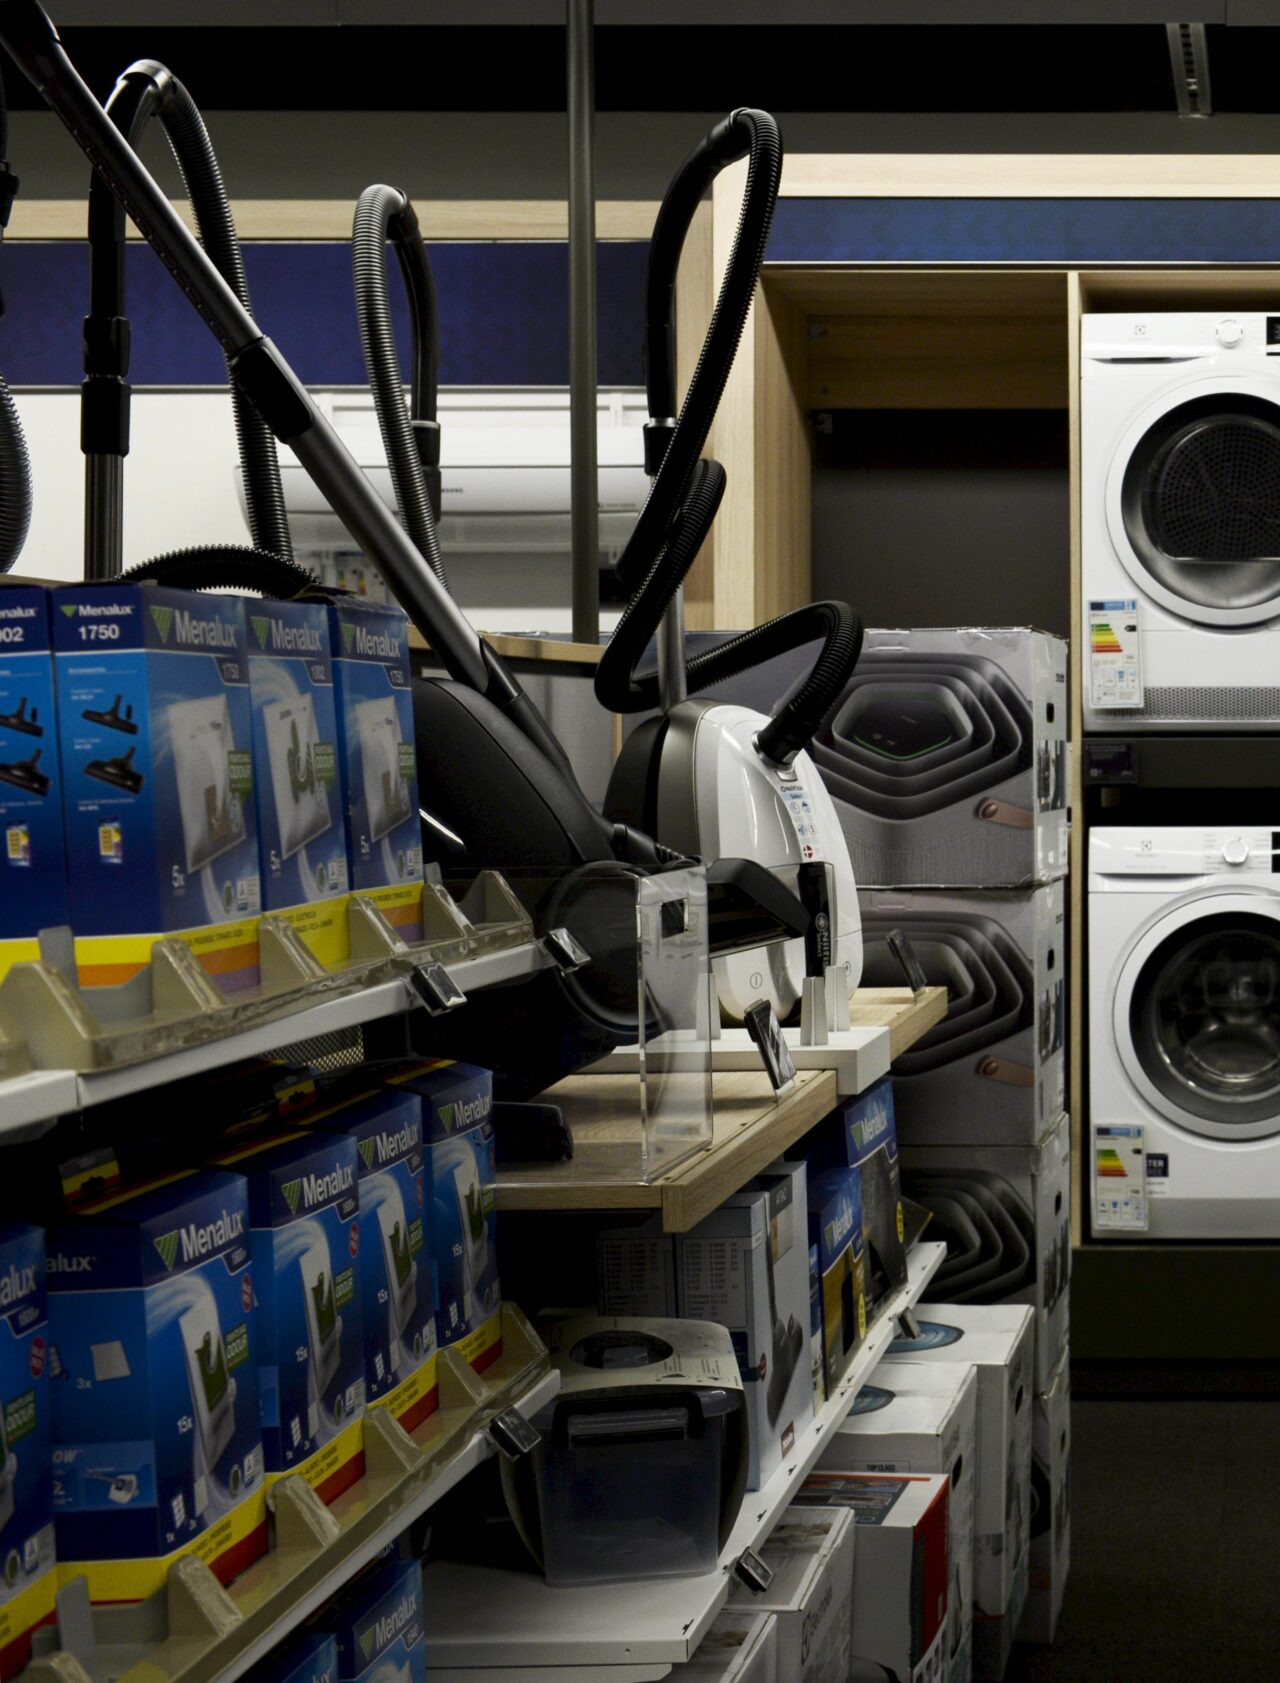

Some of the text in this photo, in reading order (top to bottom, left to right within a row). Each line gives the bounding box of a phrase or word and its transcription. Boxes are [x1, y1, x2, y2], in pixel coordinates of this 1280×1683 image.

[0, 606, 37, 618] nalux
[78, 604, 133, 617] Menalux
[79, 624, 120, 640] 1750
[174, 610, 238, 647] Menalux
[270, 619, 322, 651] Menalux
[355, 626, 401, 658] Menalux
[454, 1093, 491, 1129] Menalux
[375, 1122, 419, 1164] Menalux
[303, 1163, 353, 1209] Menalux
[180, 1210, 243, 1264] Menalux
[47, 1252, 92, 1273] alux
[0, 1264, 37, 1306] alux
[75, 1377, 93, 1390] 3x
[374, 1591, 417, 1650] Menalux
